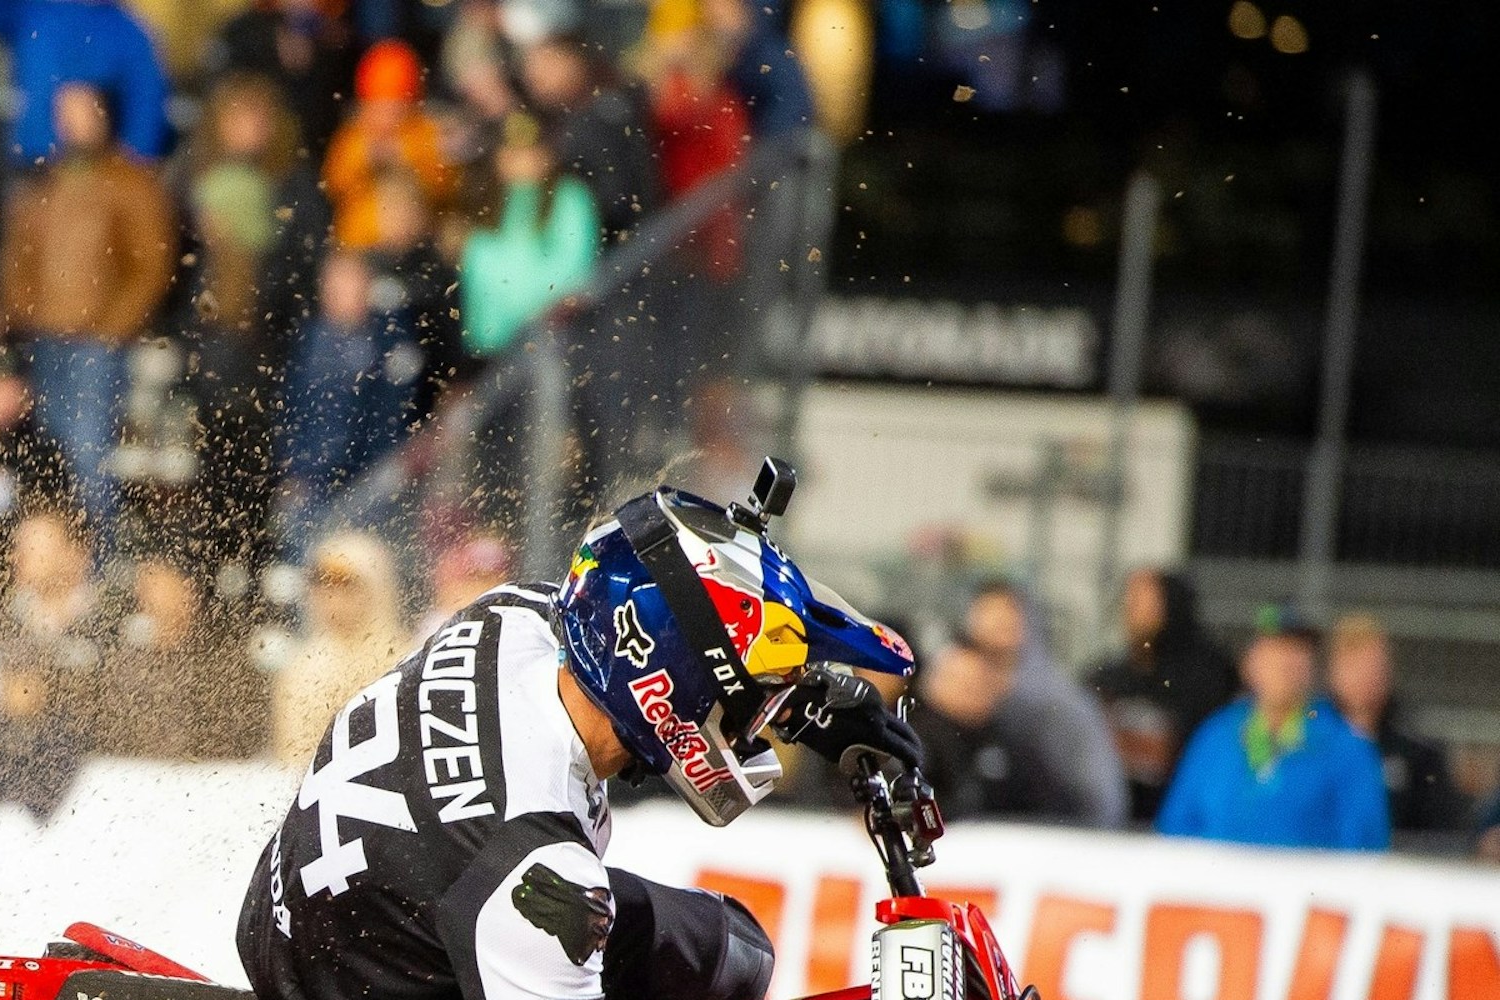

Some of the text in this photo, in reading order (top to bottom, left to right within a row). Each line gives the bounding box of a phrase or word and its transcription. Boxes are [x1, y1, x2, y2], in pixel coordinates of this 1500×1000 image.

[704, 646, 745, 696] FOX
[418, 620, 495, 823] ROCZEN
[900, 945, 934, 999] FB
